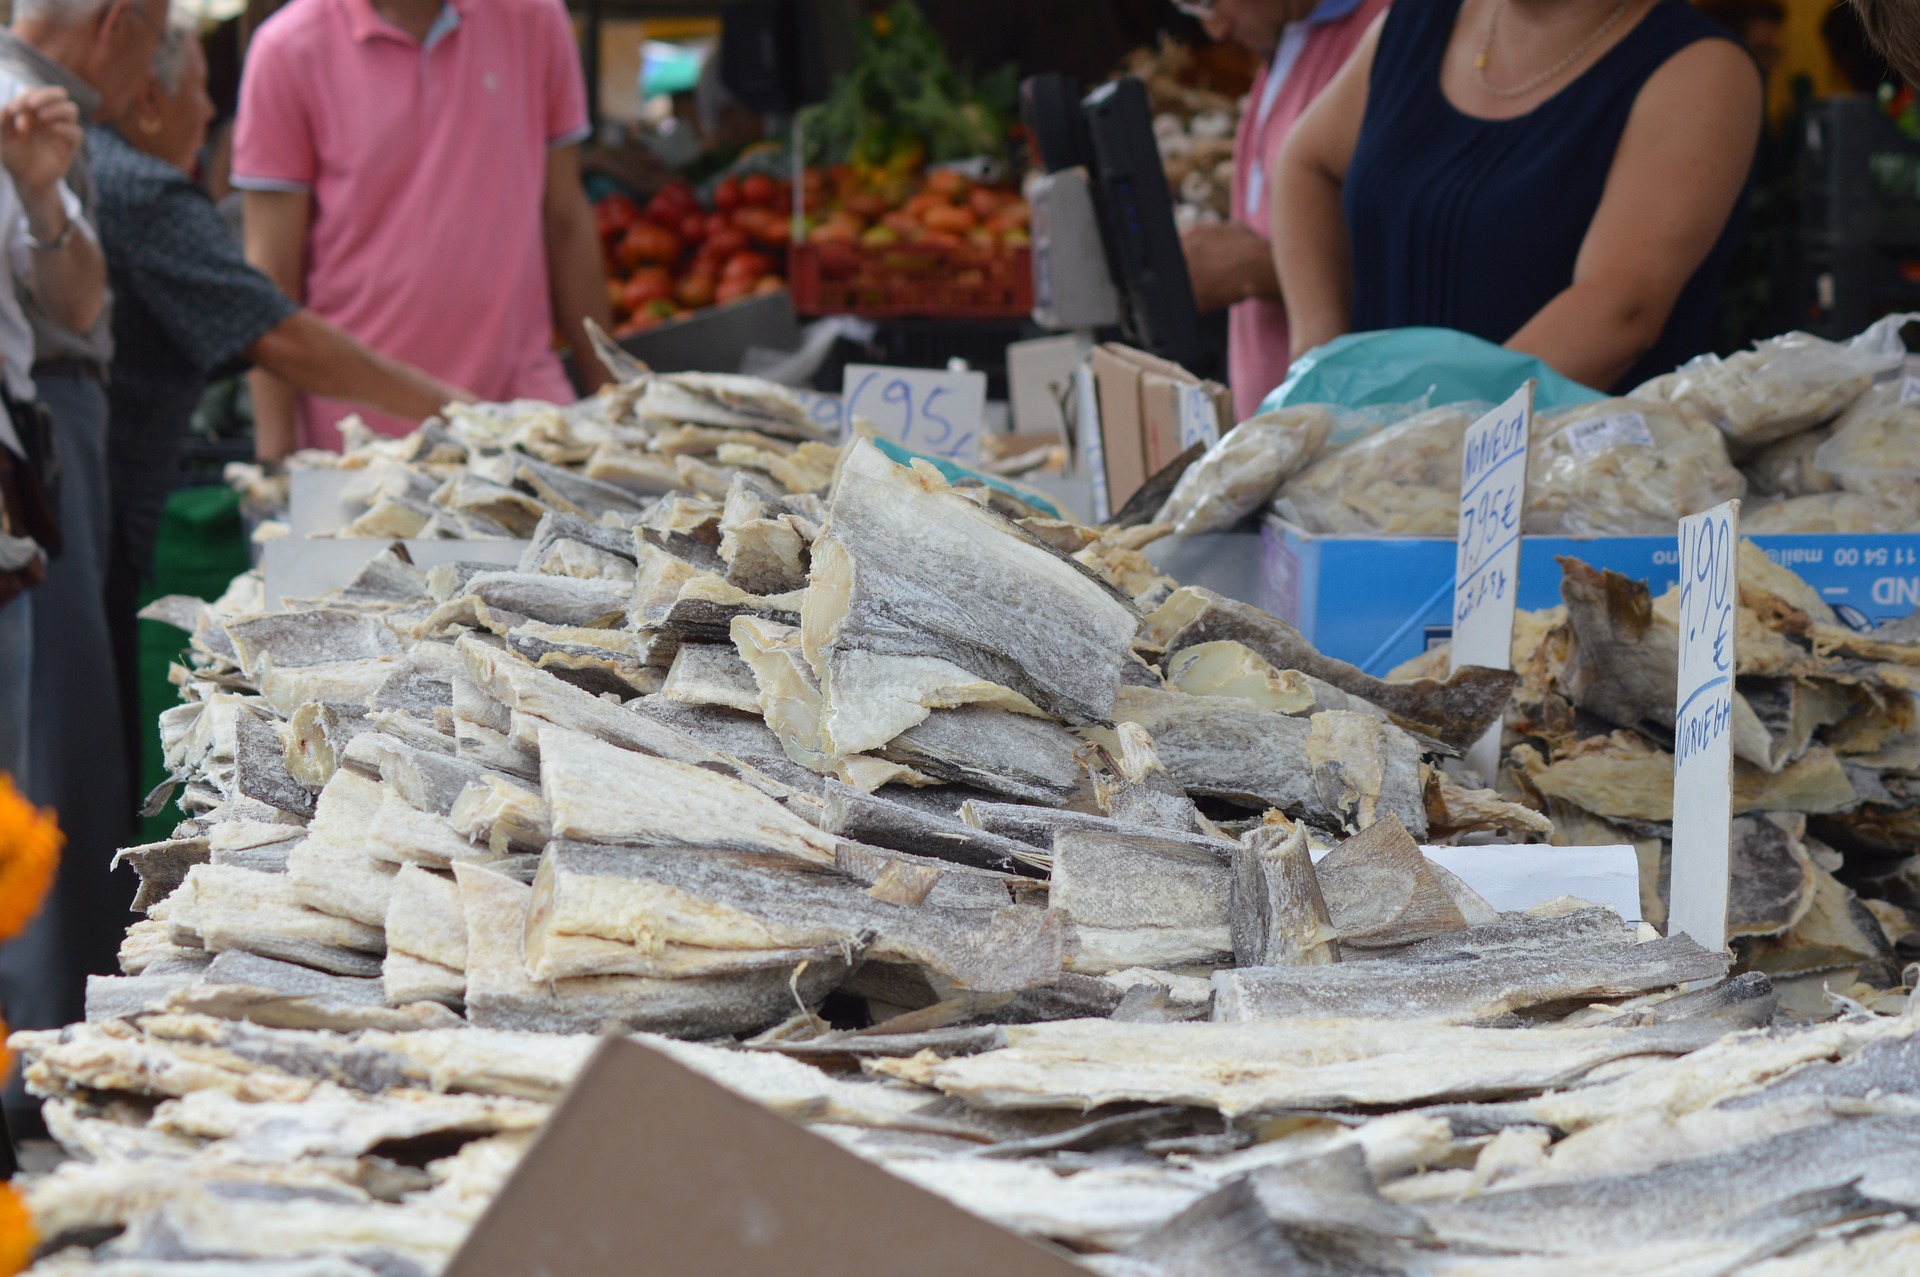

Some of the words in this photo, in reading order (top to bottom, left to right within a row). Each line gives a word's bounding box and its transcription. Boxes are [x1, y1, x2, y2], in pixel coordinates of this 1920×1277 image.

[1833, 548, 1860, 566] 00
[1864, 548, 1889, 566] 54
[1895, 548, 1917, 565] 11
